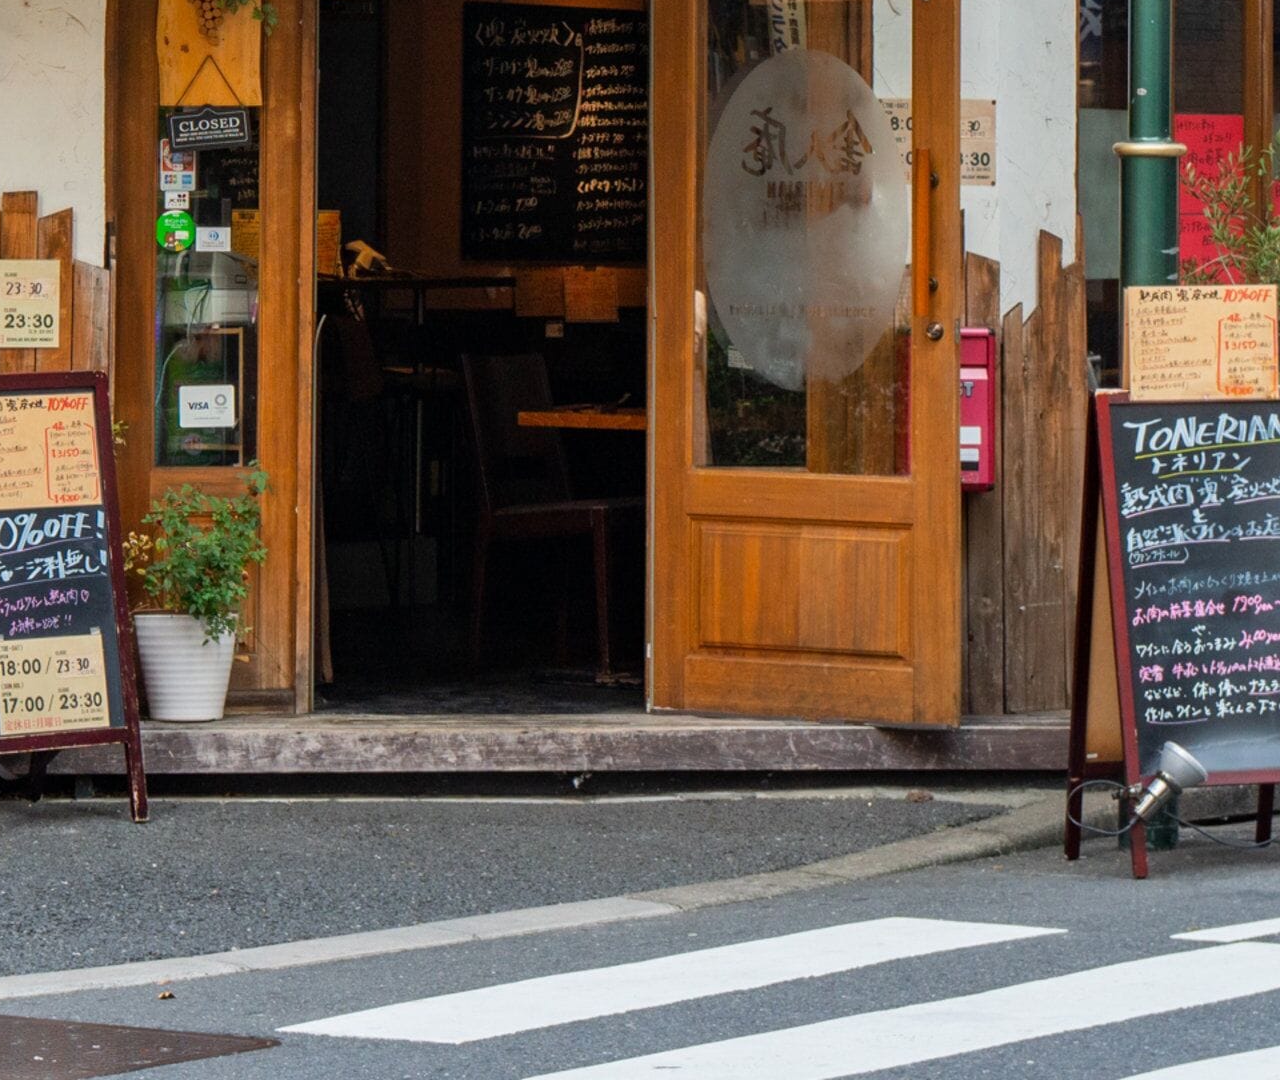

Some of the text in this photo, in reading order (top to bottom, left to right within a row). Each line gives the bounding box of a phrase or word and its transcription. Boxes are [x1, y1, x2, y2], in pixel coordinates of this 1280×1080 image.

[179, 117, 241, 133] CLOSED
[6, 281, 42, 296] 23:30
[4, 313, 54, 329] 23:30
[187, 401, 210, 411] VISA
[1151, 451, 1252, 475] トネリアン
[1193, 508, 1208, 523] と
[0, 657, 42, 677] 18:00
[56, 657, 90, 674] 23:30
[3, 695, 45, 714] 17:00
[59, 691, 103, 710] 23:30
